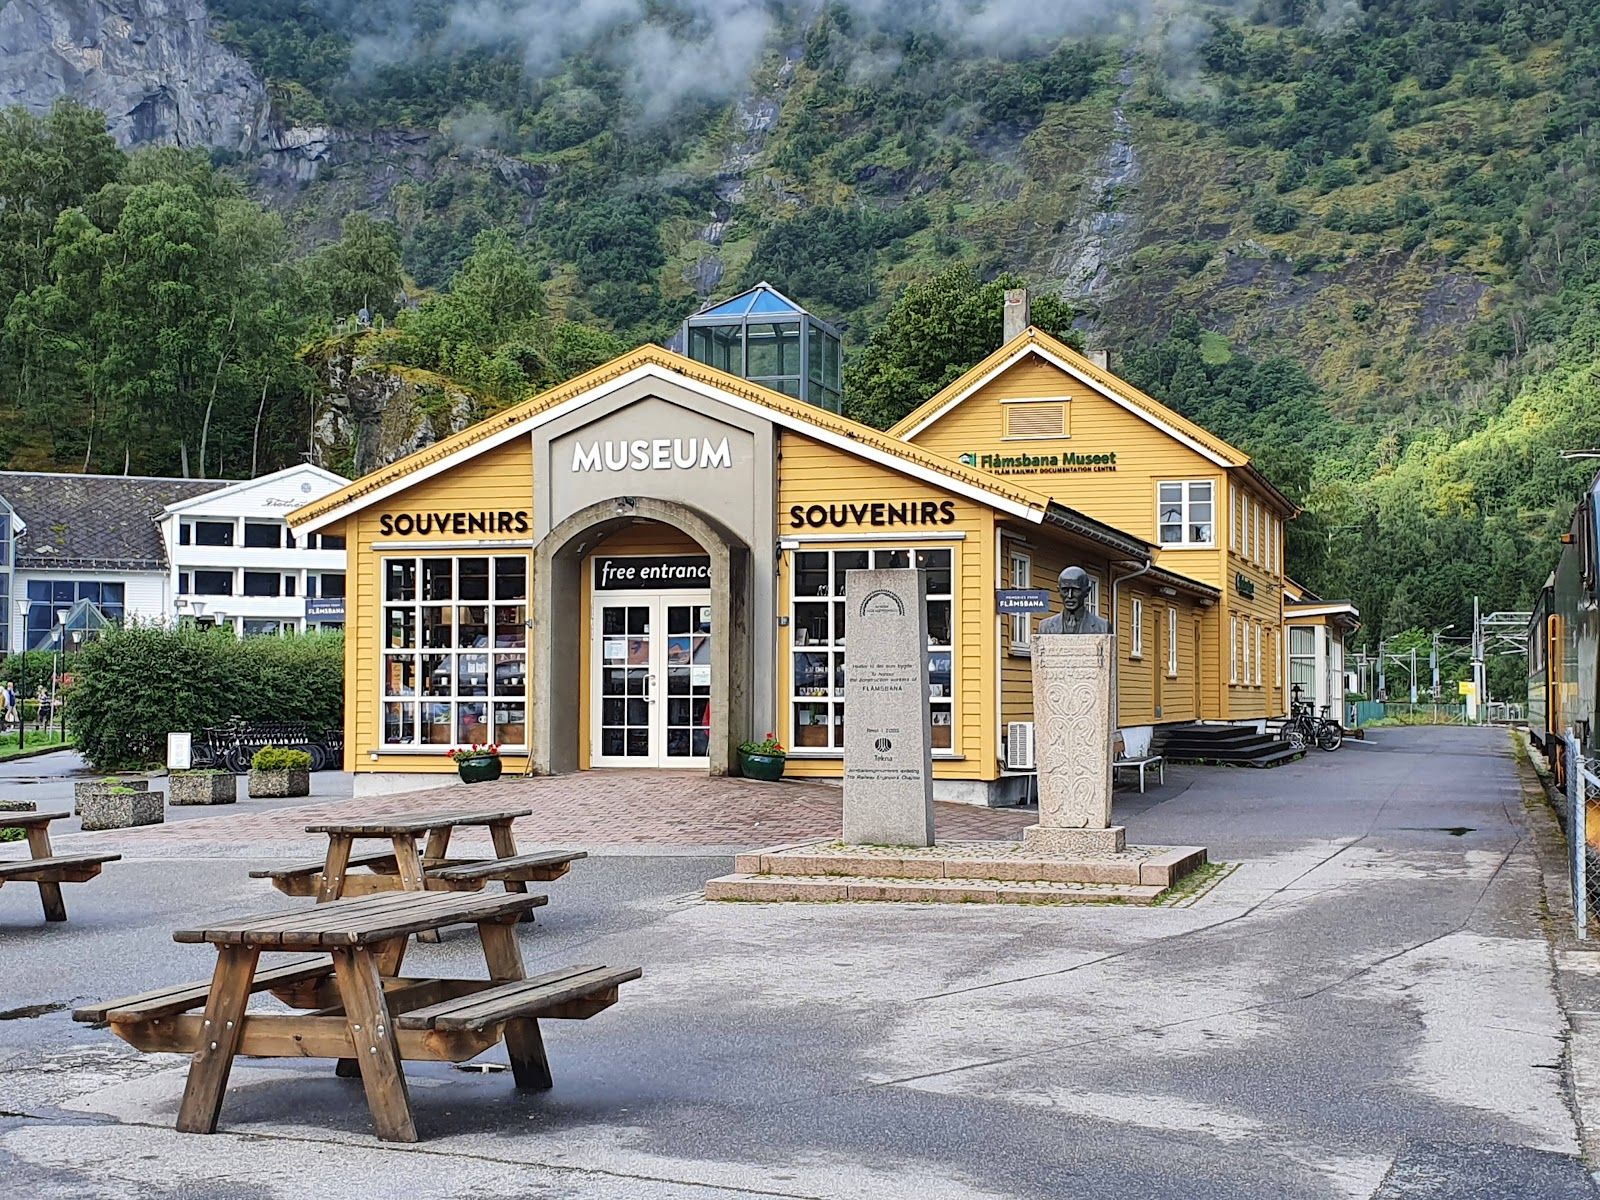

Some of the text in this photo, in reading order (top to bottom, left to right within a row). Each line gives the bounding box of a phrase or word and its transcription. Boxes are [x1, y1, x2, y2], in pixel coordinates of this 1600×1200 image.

[571, 436, 732, 472] MUSEUM
[981, 451, 1117, 468] Flåmsbana Museet
[1039, 466, 1092, 474] DOCUMENTATION
[380, 511, 528, 536] SOUVENIRS
[790, 501, 955, 528] SOUVENIRS
[601, 560, 636, 587] free
[999, 599, 1044, 607] FLÅMSBANA
